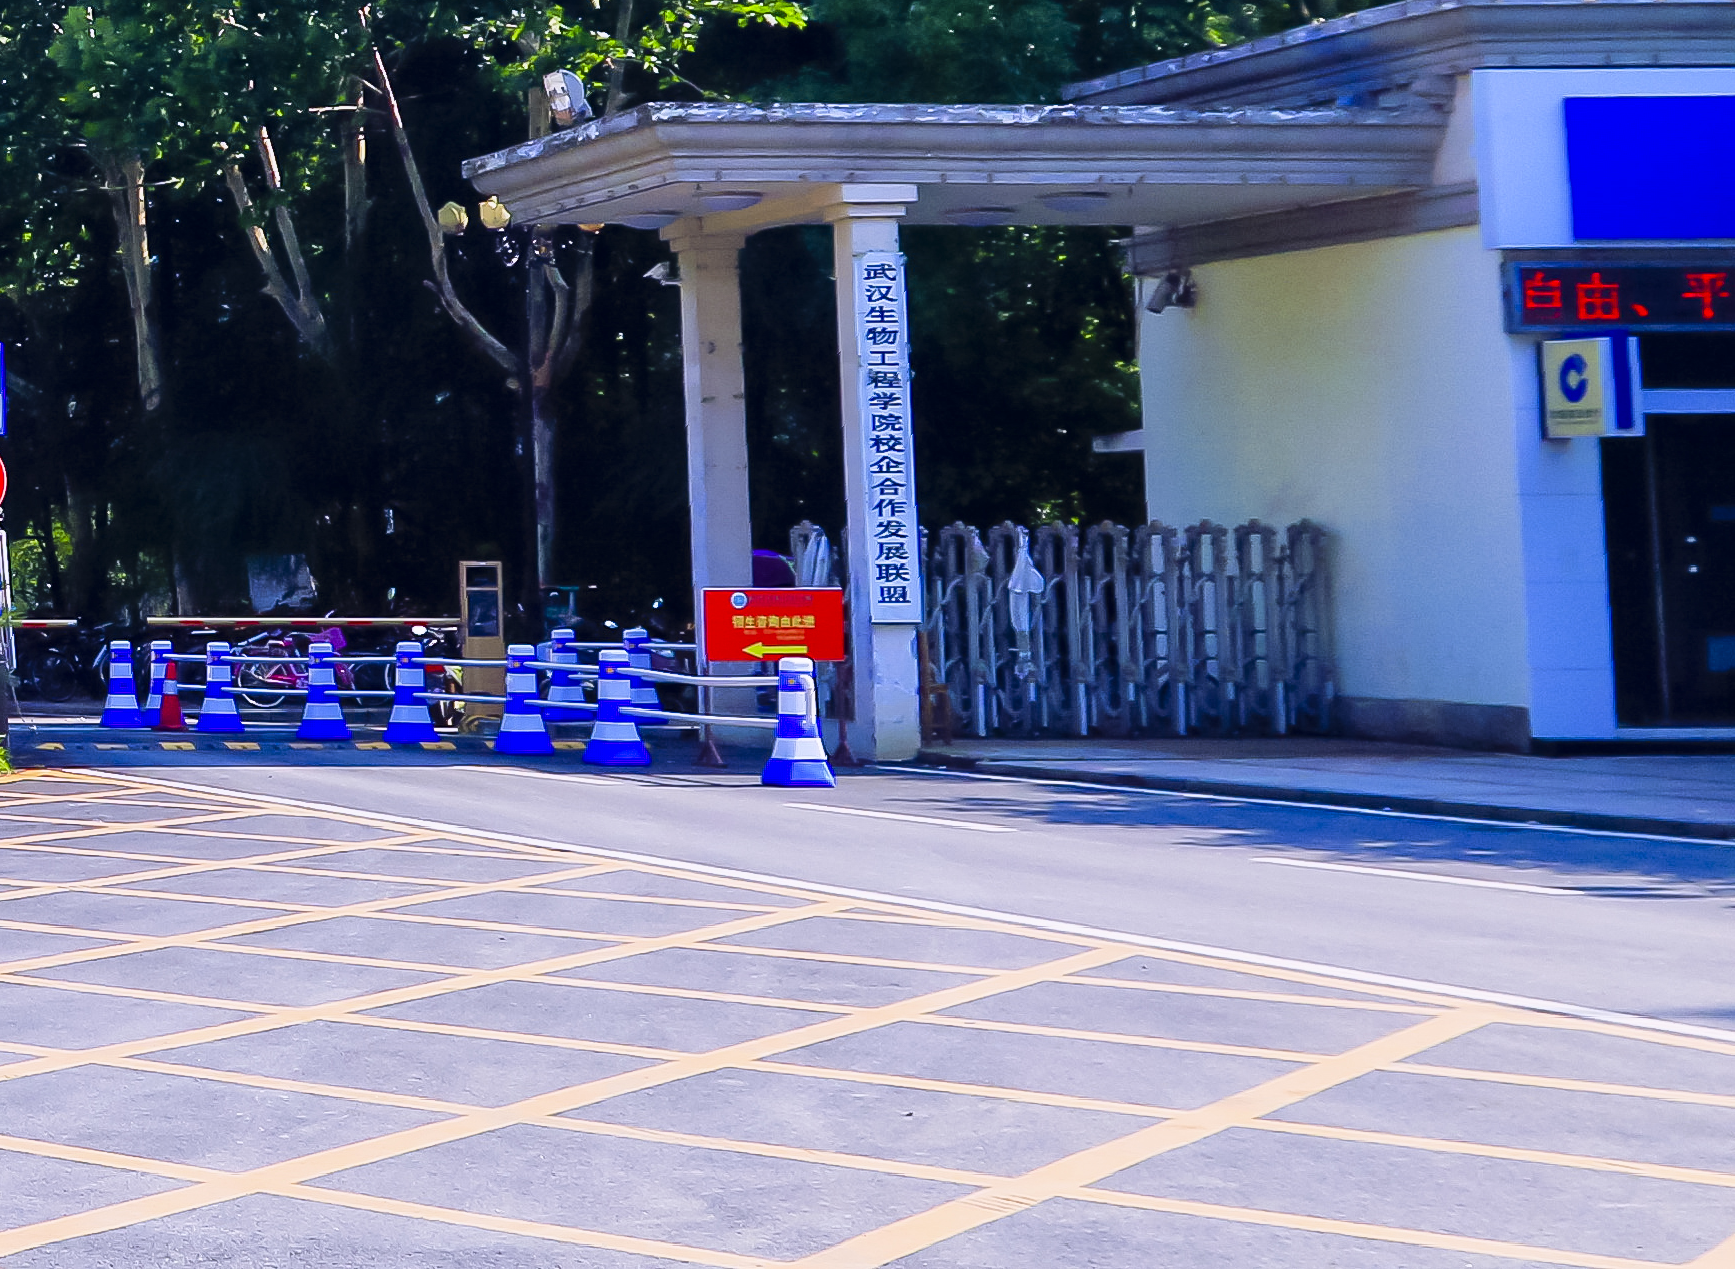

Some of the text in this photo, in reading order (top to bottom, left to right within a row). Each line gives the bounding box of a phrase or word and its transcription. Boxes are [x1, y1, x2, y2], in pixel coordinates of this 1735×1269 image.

[863, 261, 912, 604] 武汉生物工程学院校企合作发展联盟
